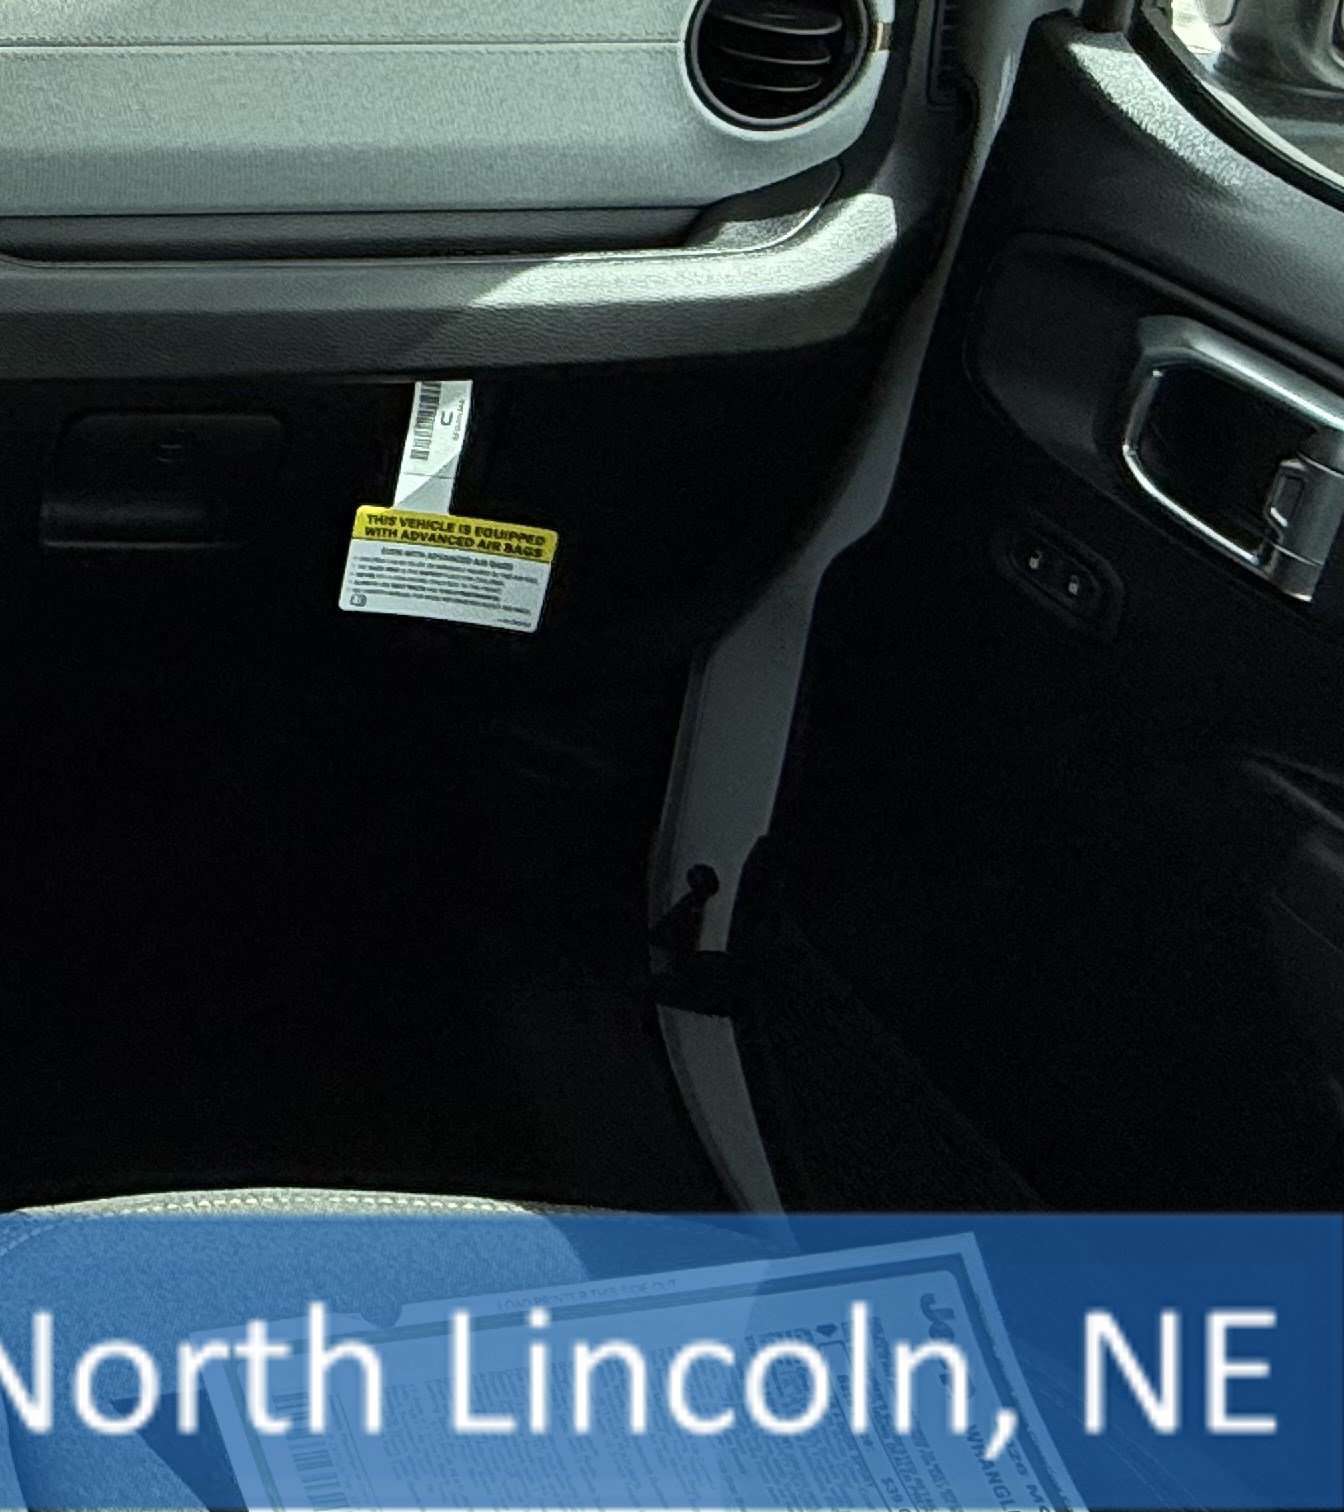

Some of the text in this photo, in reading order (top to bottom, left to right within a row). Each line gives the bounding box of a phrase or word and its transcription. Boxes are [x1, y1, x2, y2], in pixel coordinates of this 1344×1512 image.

[365, 527, 544, 558] WITH ADVANCED AIR BAGS
[367, 513, 546, 545] THIS VEHICLE IS EQUIPPED
